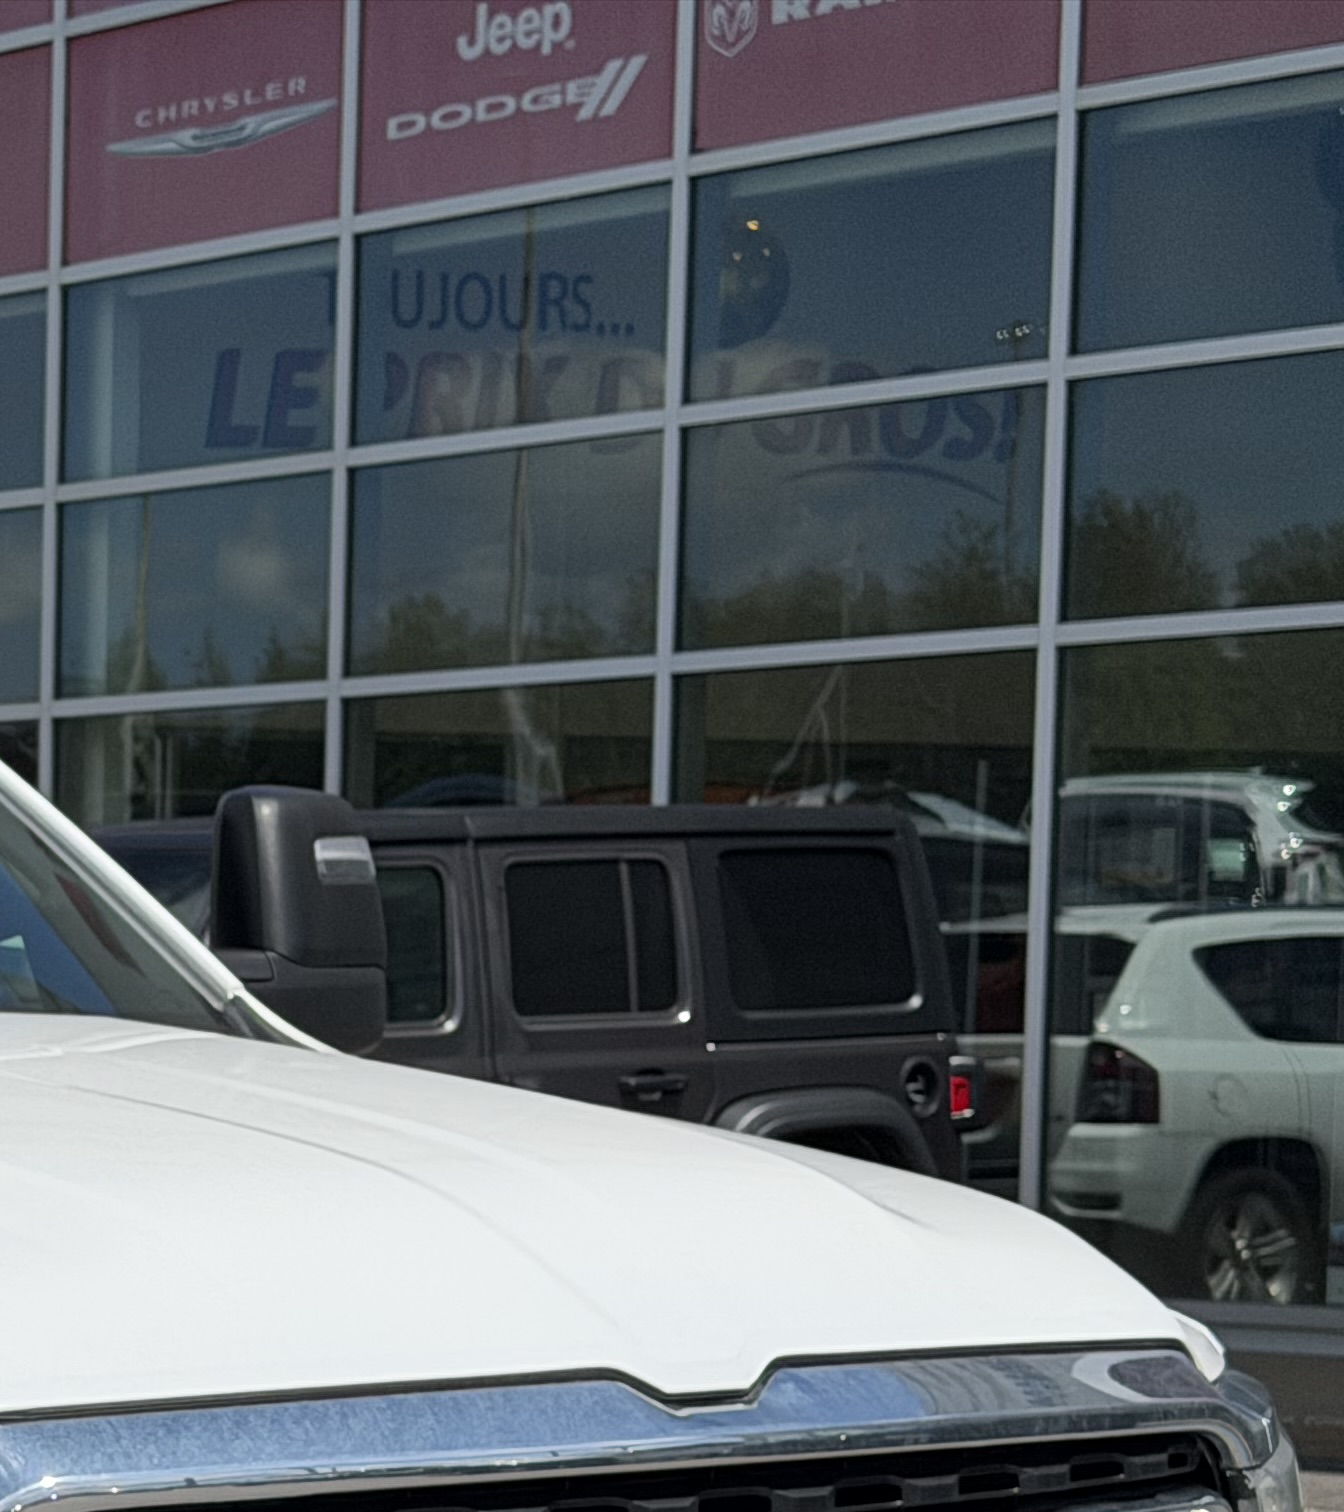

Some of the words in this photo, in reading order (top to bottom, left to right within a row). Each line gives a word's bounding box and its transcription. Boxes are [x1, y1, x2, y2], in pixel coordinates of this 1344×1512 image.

[456, 2, 573, 61] Jeep
[134, 76, 307, 129] CHRYSLER
[386, 74, 602, 141] DODGE
[323, 268, 635, 337] TUJOURS...
[204, 346, 330, 449] LE
